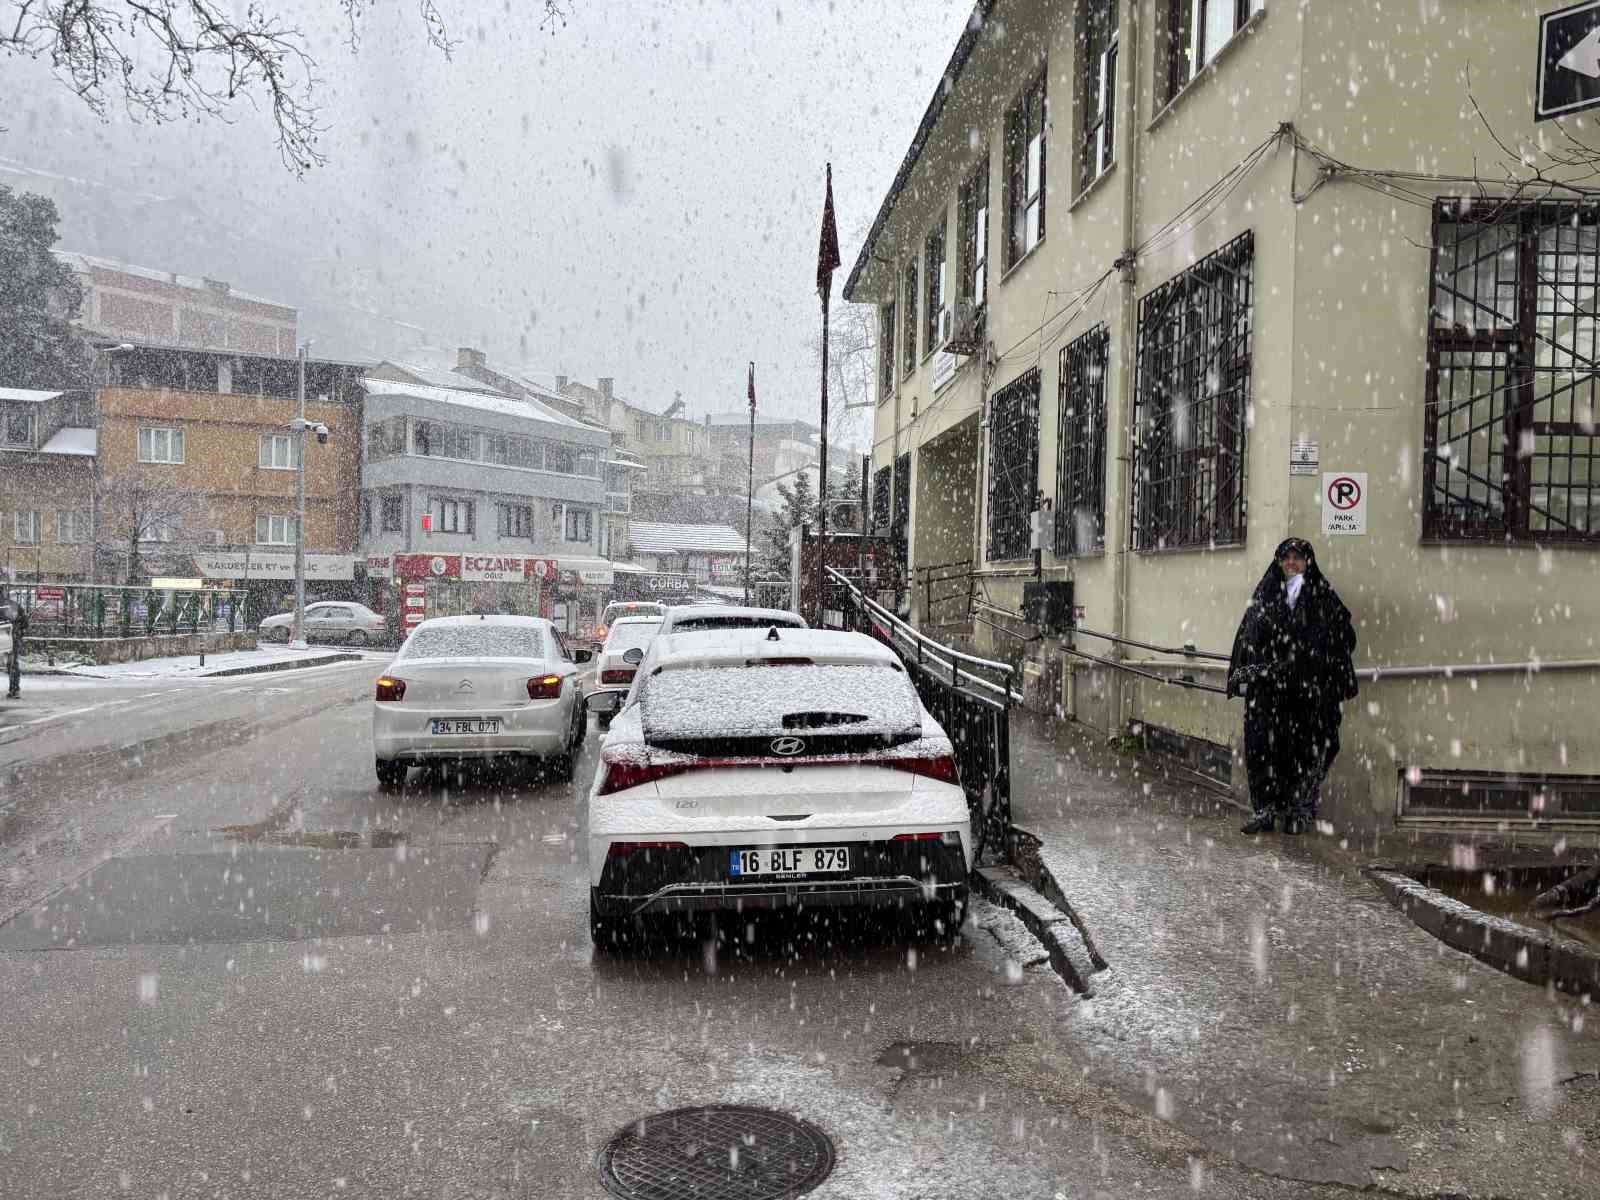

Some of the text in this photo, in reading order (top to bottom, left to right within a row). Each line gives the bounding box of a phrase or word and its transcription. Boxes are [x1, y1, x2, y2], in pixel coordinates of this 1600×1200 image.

[1333, 514, 1353, 522] PARK
[1328, 523, 1359, 531] APILA
[464, 556, 522, 572] ECZANE
[440, 721, 452, 733] 34
[456, 721, 474, 733] FBL
[479, 721, 497, 733] 071
[741, 848, 848, 873] 16 BLF 879
